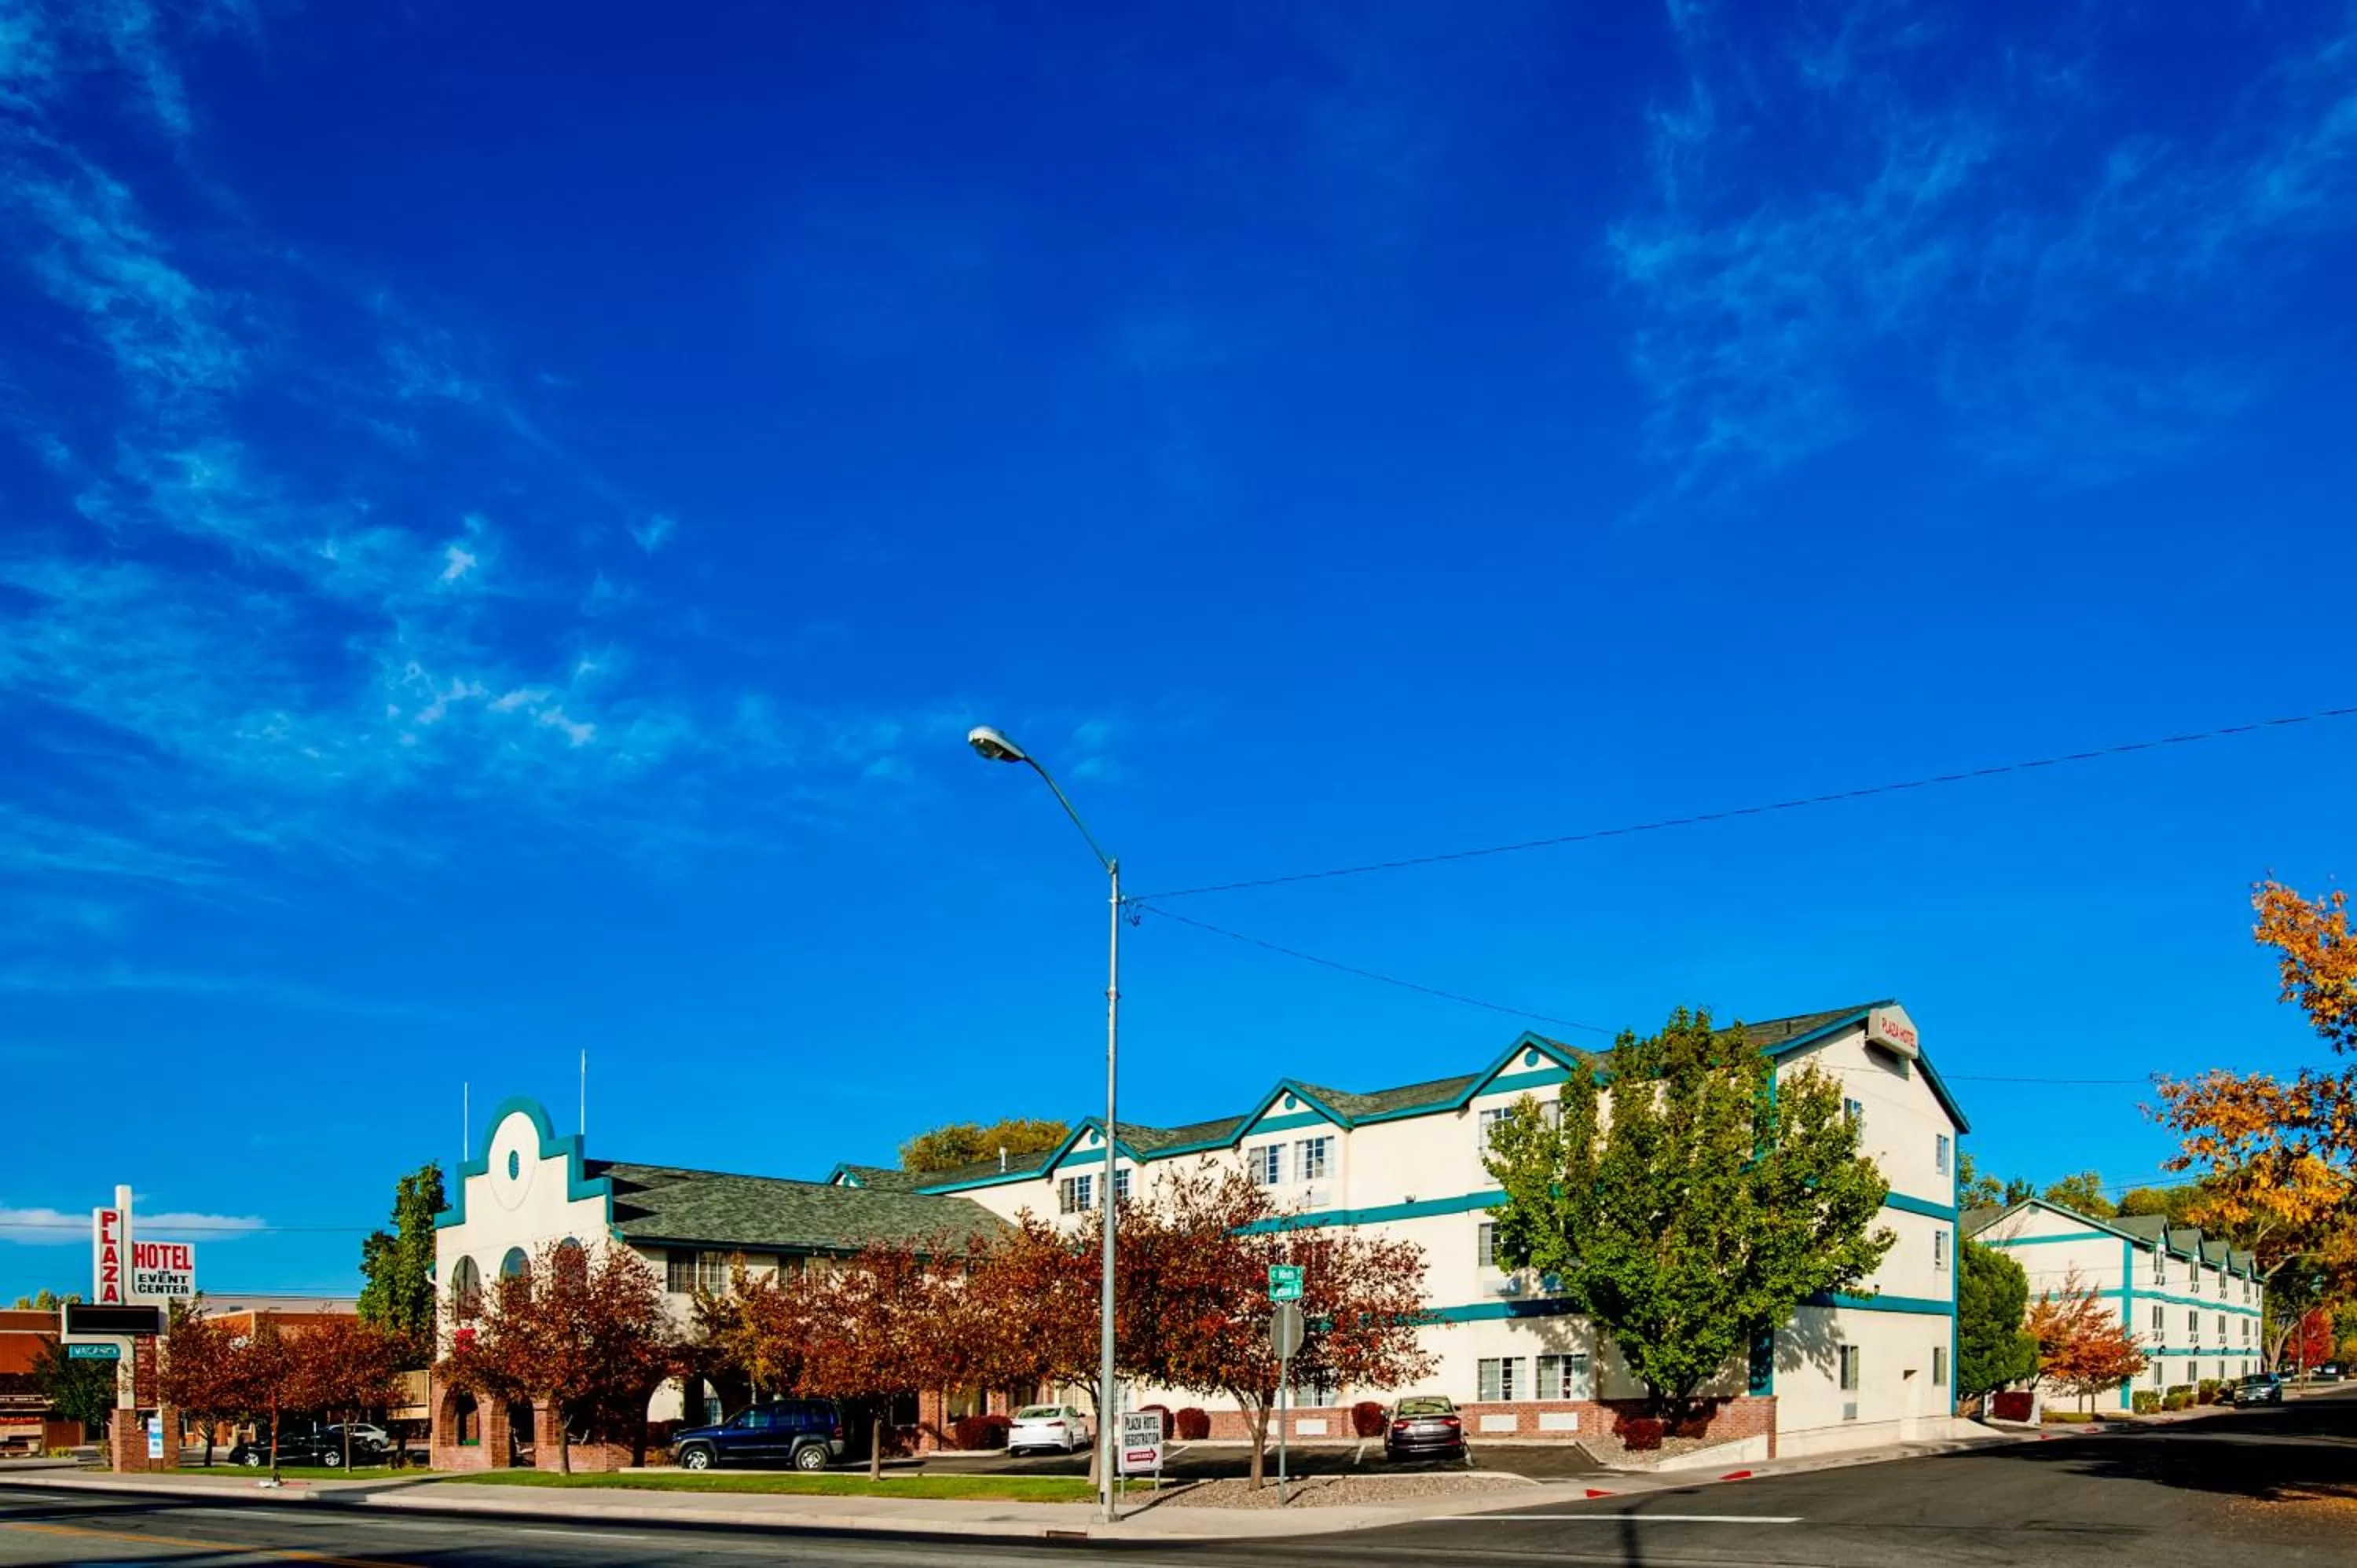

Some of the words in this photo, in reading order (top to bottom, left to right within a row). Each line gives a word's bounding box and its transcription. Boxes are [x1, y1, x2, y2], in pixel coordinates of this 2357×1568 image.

[1882, 1017, 1899, 1037] PLAZA
[1900, 1029, 1915, 1048] HOTEL
[101, 1211, 118, 1302] PLAZA
[134, 1244, 192, 1270] HOTEL
[137, 1273, 189, 1284] EVENT
[137, 1284, 189, 1295] CENTER
[75, 1346, 118, 1356] VACANCY
[1125, 1416, 1141, 1431] PLAZA
[1144, 1416, 1159, 1429] HOTEL
[1124, 1432, 1159, 1446] REGISTRATION
